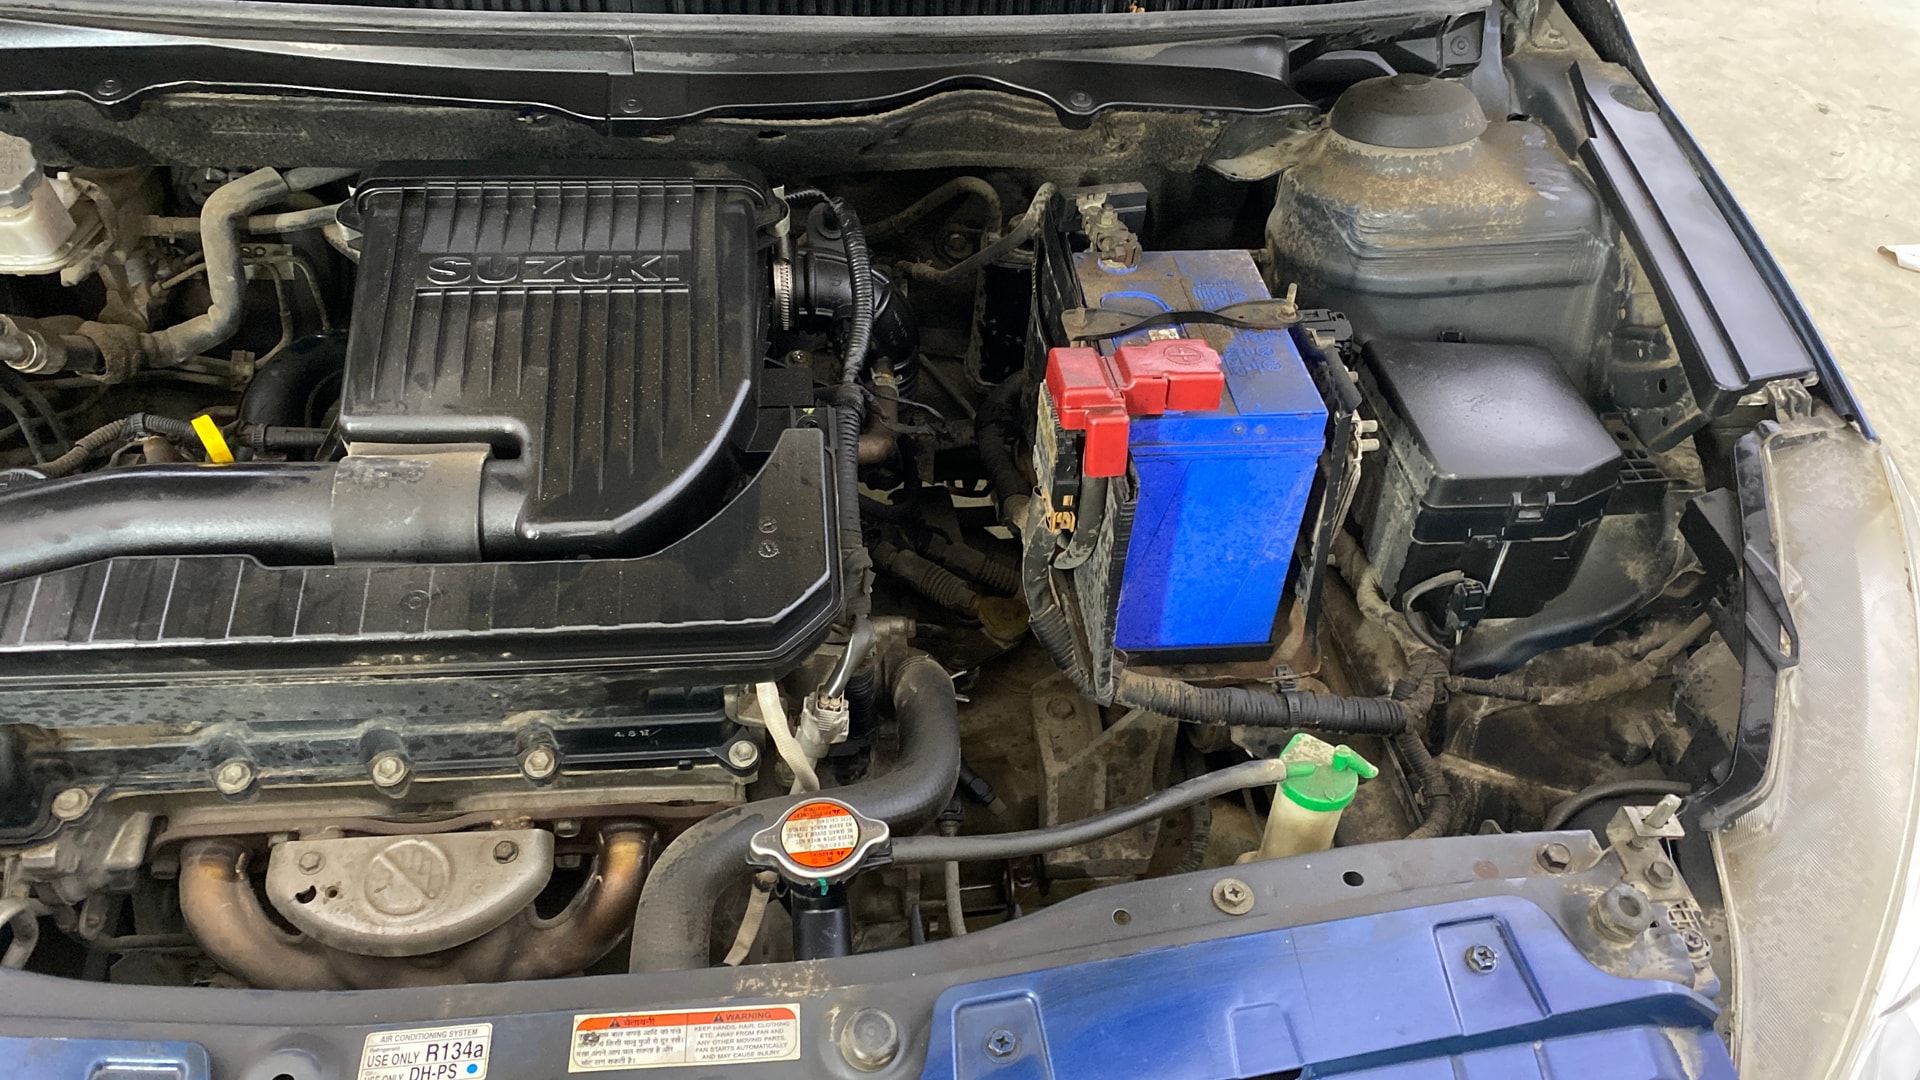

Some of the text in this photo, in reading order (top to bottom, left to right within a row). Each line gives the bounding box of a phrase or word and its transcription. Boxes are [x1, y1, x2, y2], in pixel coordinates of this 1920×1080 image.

[426, 255, 680, 285] SUZUKI
[726, 1011, 771, 1021] WARNING
[380, 1028, 478, 1043] AIR CONDITIONING SYSTEM
[367, 1040, 484, 1068] USE ONLY R134a
[736, 1042, 788, 1051] AUTOMATICALLY
[409, 1063, 458, 1080] DH-PS
